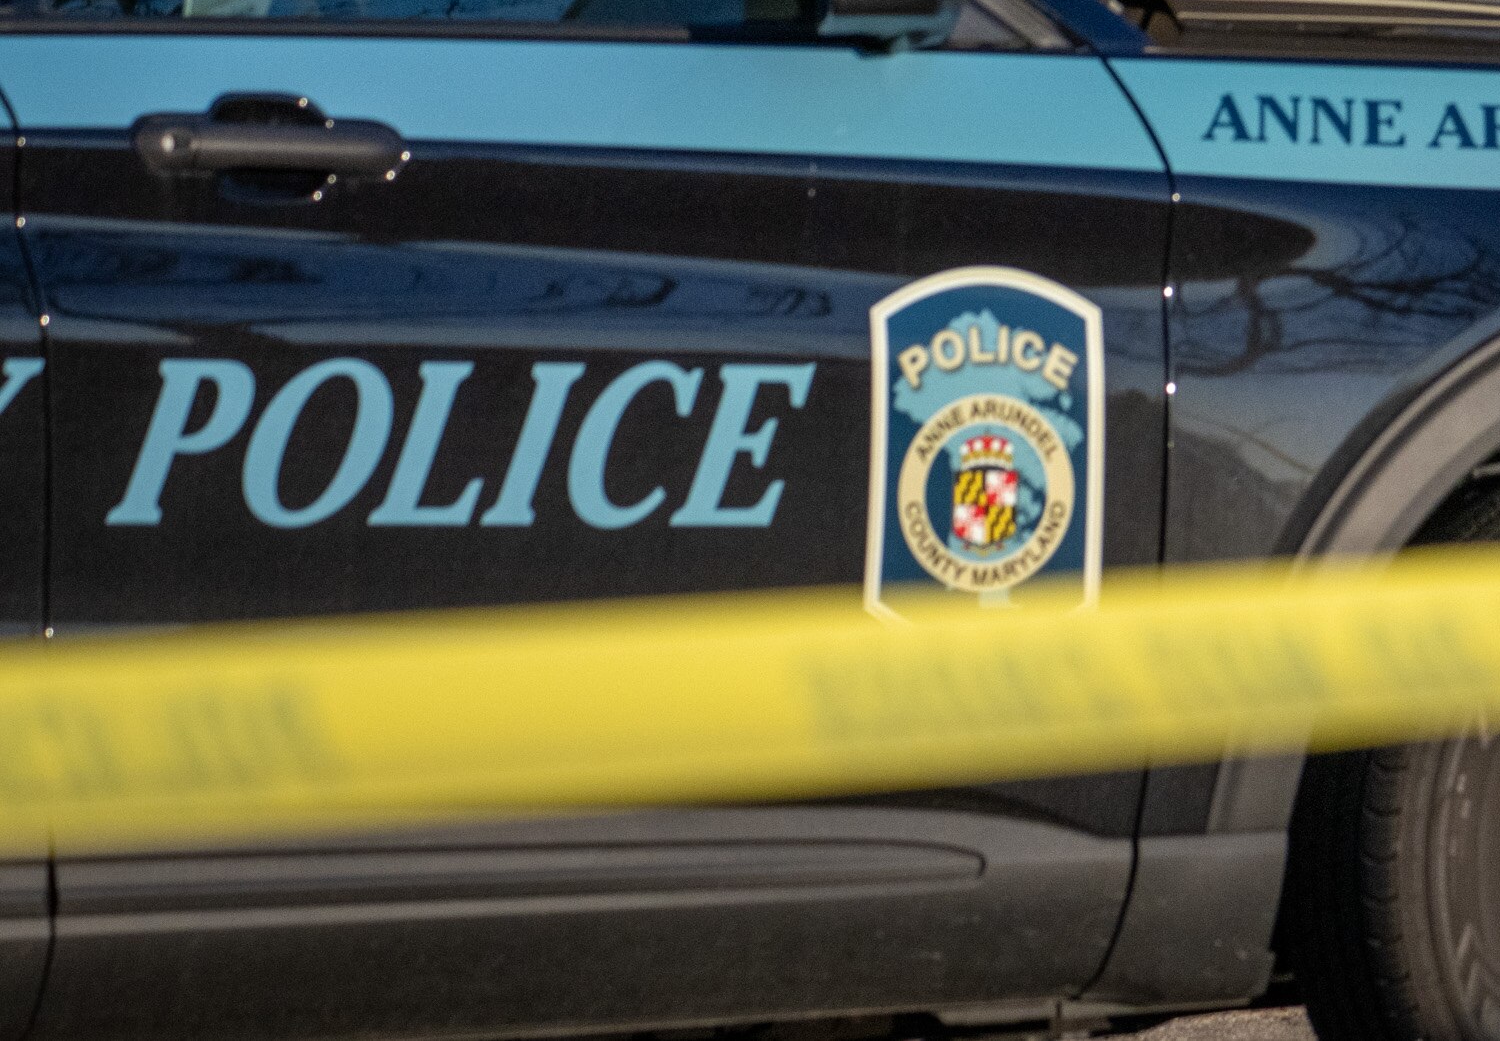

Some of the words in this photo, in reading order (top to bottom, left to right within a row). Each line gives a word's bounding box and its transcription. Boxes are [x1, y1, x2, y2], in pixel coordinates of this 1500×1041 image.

[1201, 92, 1406, 149] ANNE
[898, 324, 1079, 391] POLICE
[104, 357, 817, 529] POLICE
[916, 411, 963, 463] ANNE
[971, 400, 1060, 457] ARUNDEL
[905, 500, 969, 582] COUNTY
[970, 500, 1067, 587] MARYLAND
